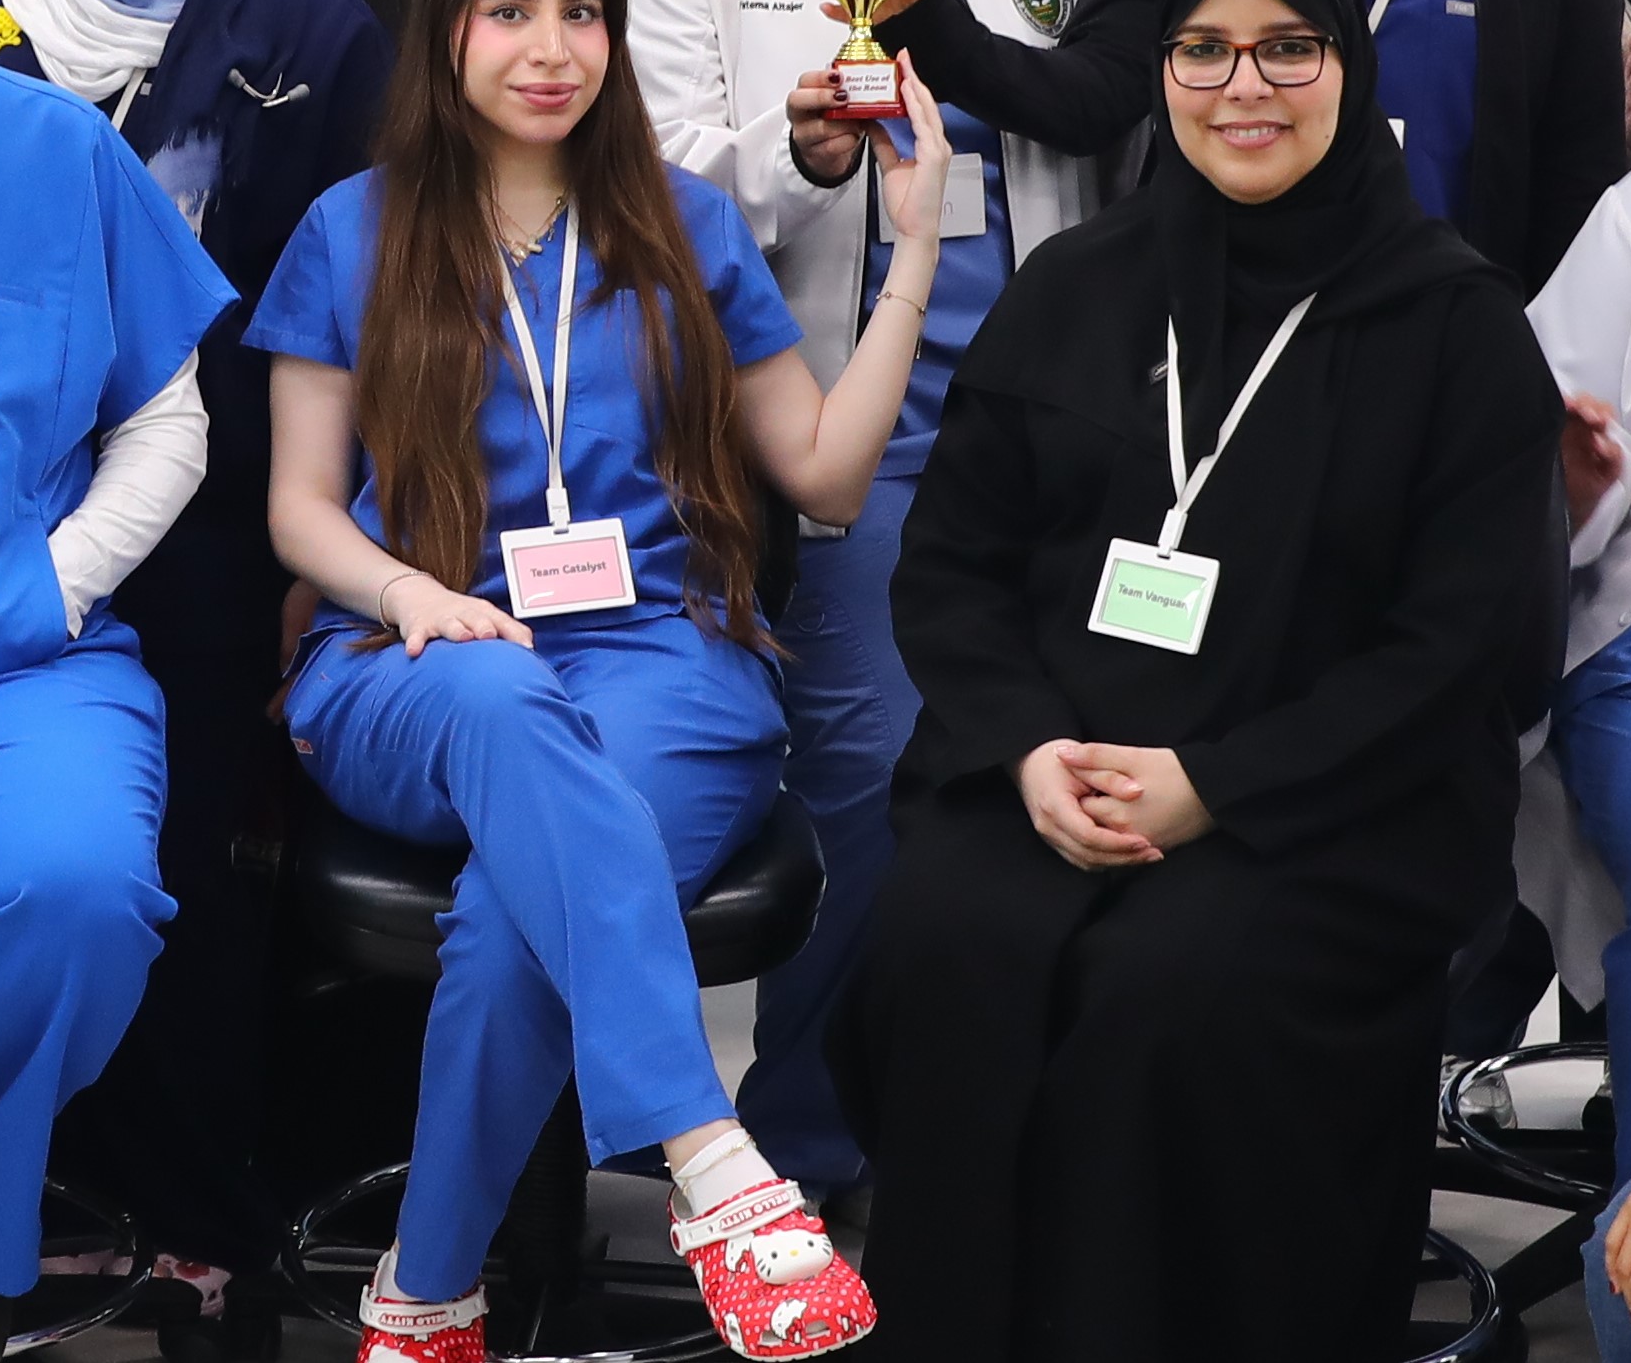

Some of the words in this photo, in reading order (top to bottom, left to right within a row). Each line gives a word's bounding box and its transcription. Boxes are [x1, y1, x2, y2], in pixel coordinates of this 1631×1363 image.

[530, 567, 560, 578] Team
[562, 560, 607, 575] Catalyst
[1118, 583, 1143, 599] Team
[1145, 590, 1188, 610] Vanguar
[720, 1207, 754, 1230] KITTY
[380, 1314, 414, 1327] KITTY
